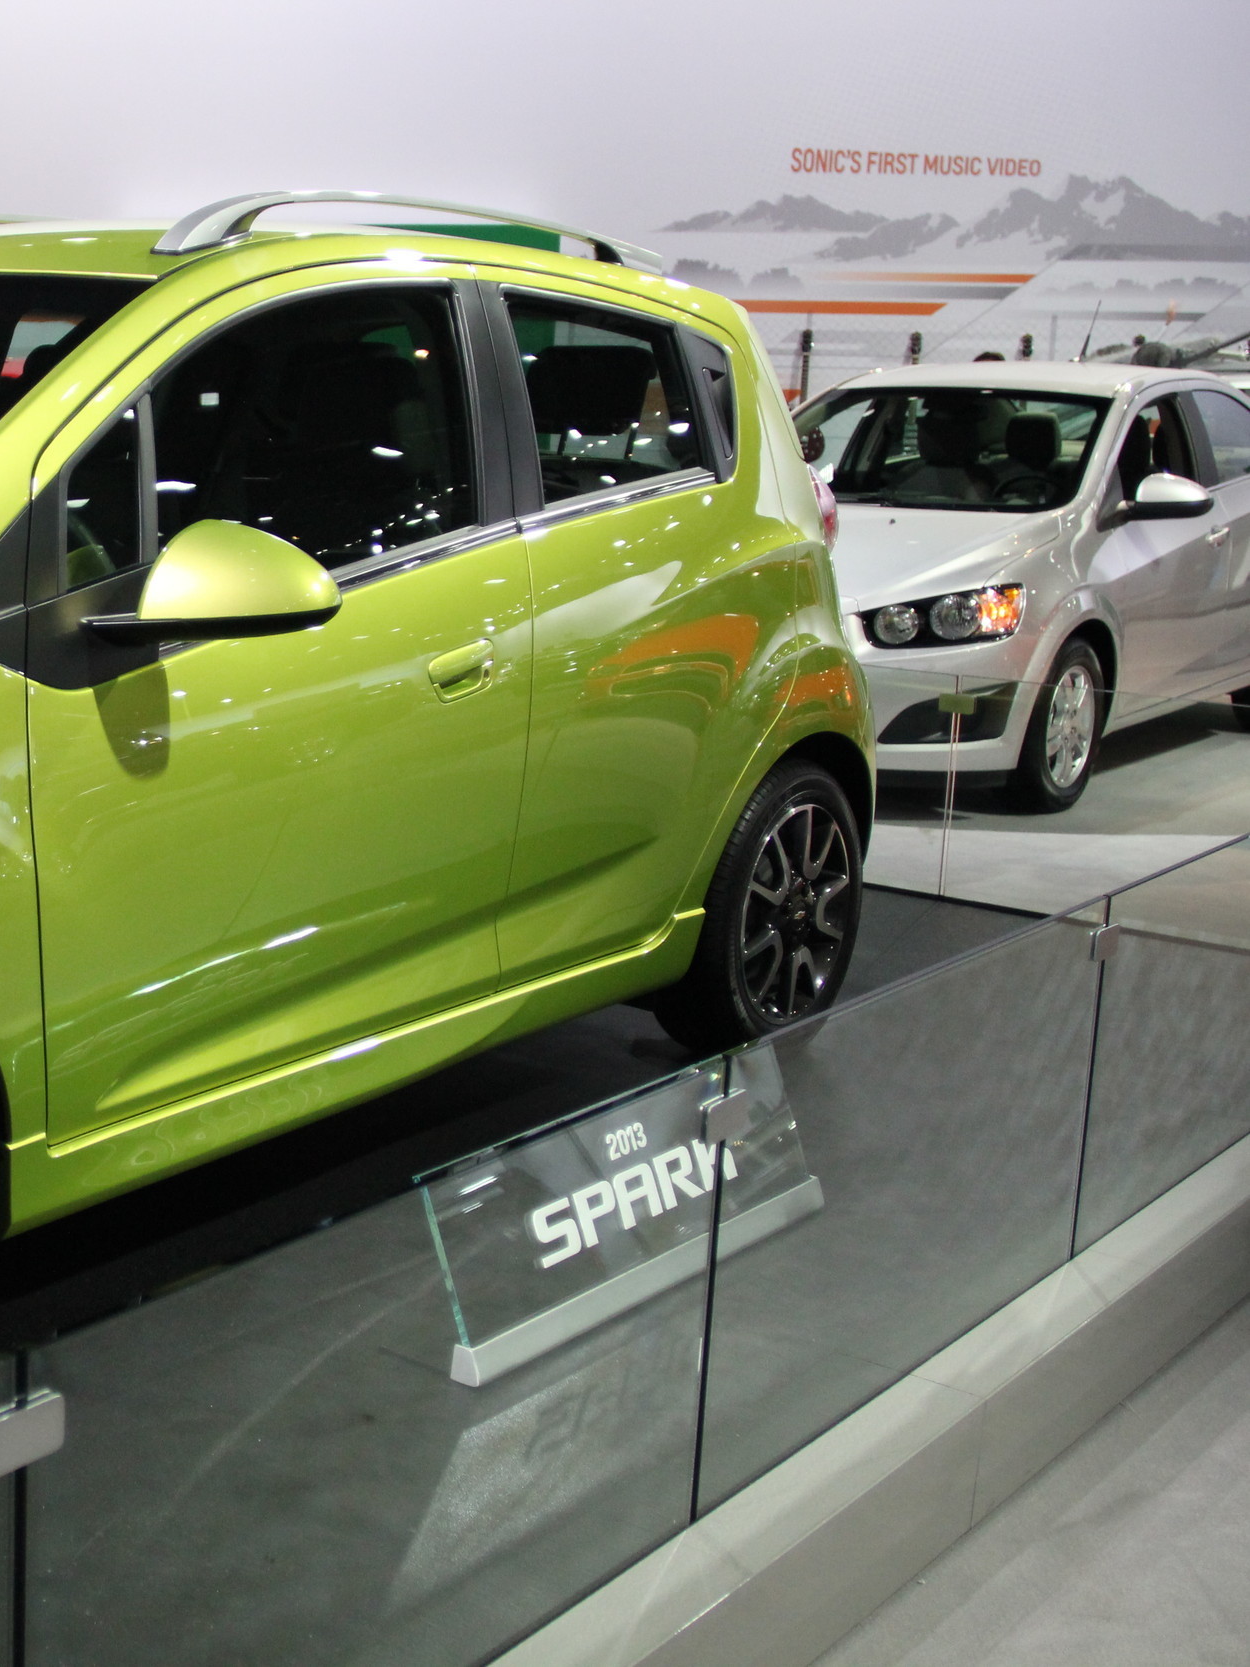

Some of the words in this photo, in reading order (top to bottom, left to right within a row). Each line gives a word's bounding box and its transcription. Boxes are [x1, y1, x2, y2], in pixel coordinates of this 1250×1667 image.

[791, 148, 862, 173] SONIC'S
[866, 151, 919, 174] FIRST
[923, 155, 982, 175] MUSIC
[987, 158, 1042, 177] VIDEO
[605, 1122, 647, 1161] 2013
[533, 1139, 738, 1269] SPARK
